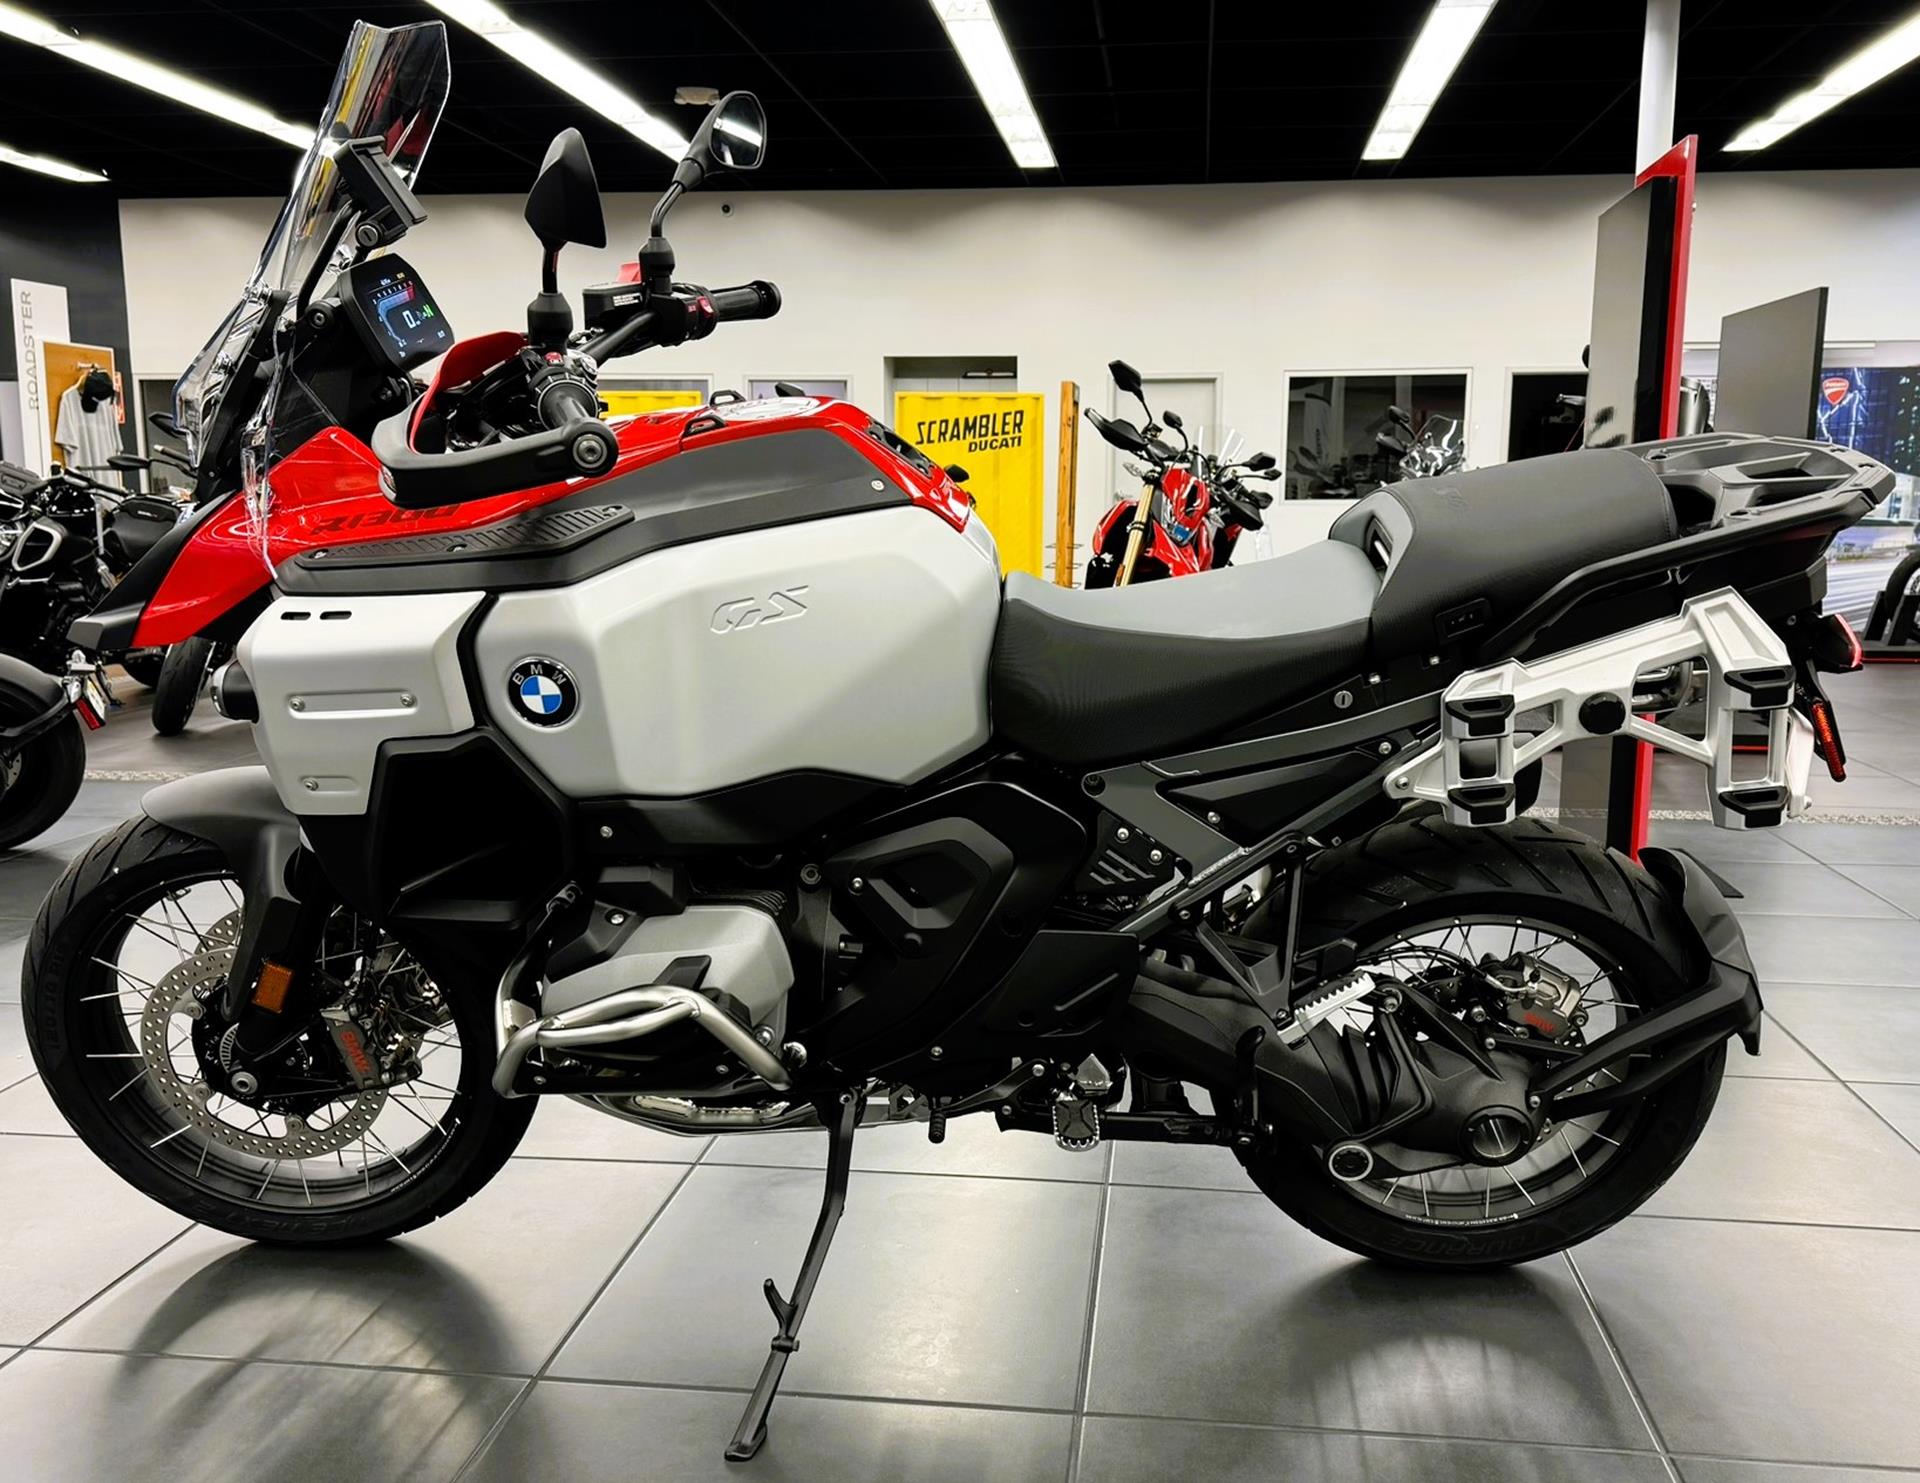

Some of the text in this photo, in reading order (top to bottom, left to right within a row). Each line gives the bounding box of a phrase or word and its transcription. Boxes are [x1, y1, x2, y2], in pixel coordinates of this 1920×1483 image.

[20, 290, 39, 411] ROADSTER
[915, 409, 1025, 446] SCRAMBLER
[967, 435, 1023, 453] DUCATI
[710, 584, 809, 635] GS
[511, 663, 567, 686] BMW
